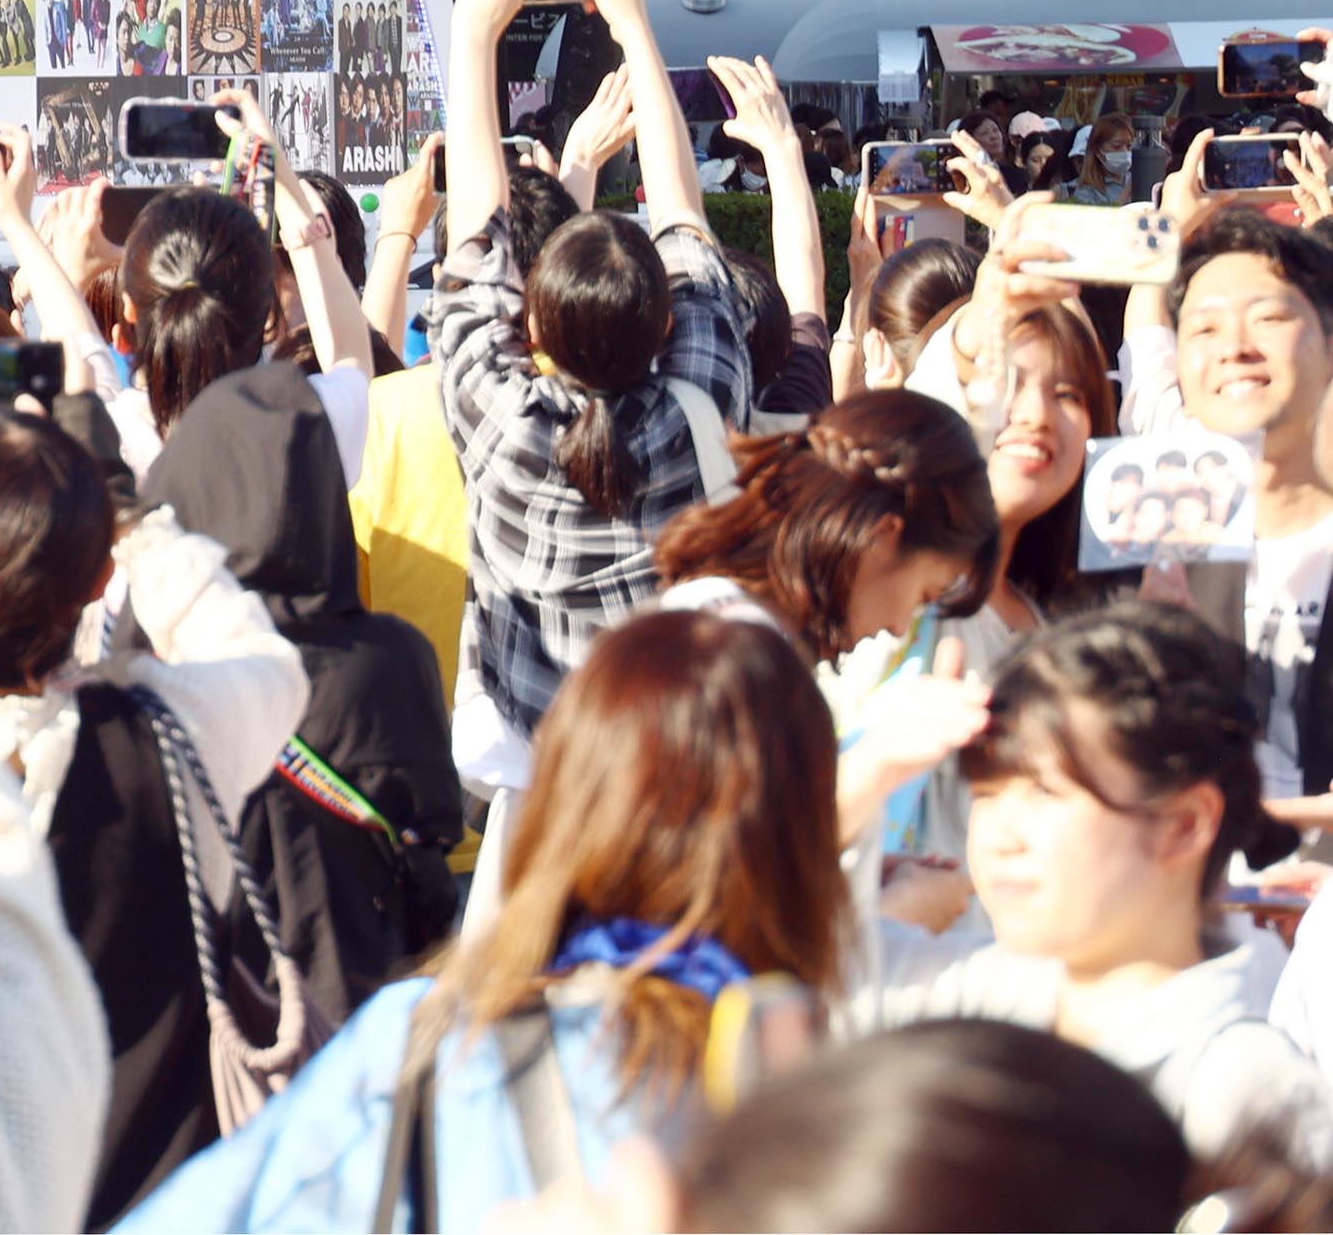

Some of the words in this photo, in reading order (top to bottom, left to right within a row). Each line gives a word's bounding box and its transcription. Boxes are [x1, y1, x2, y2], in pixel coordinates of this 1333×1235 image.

[301, 46, 312, 55] You
[313, 46, 325, 55] Call
[342, 145, 401, 173] ARASHI
